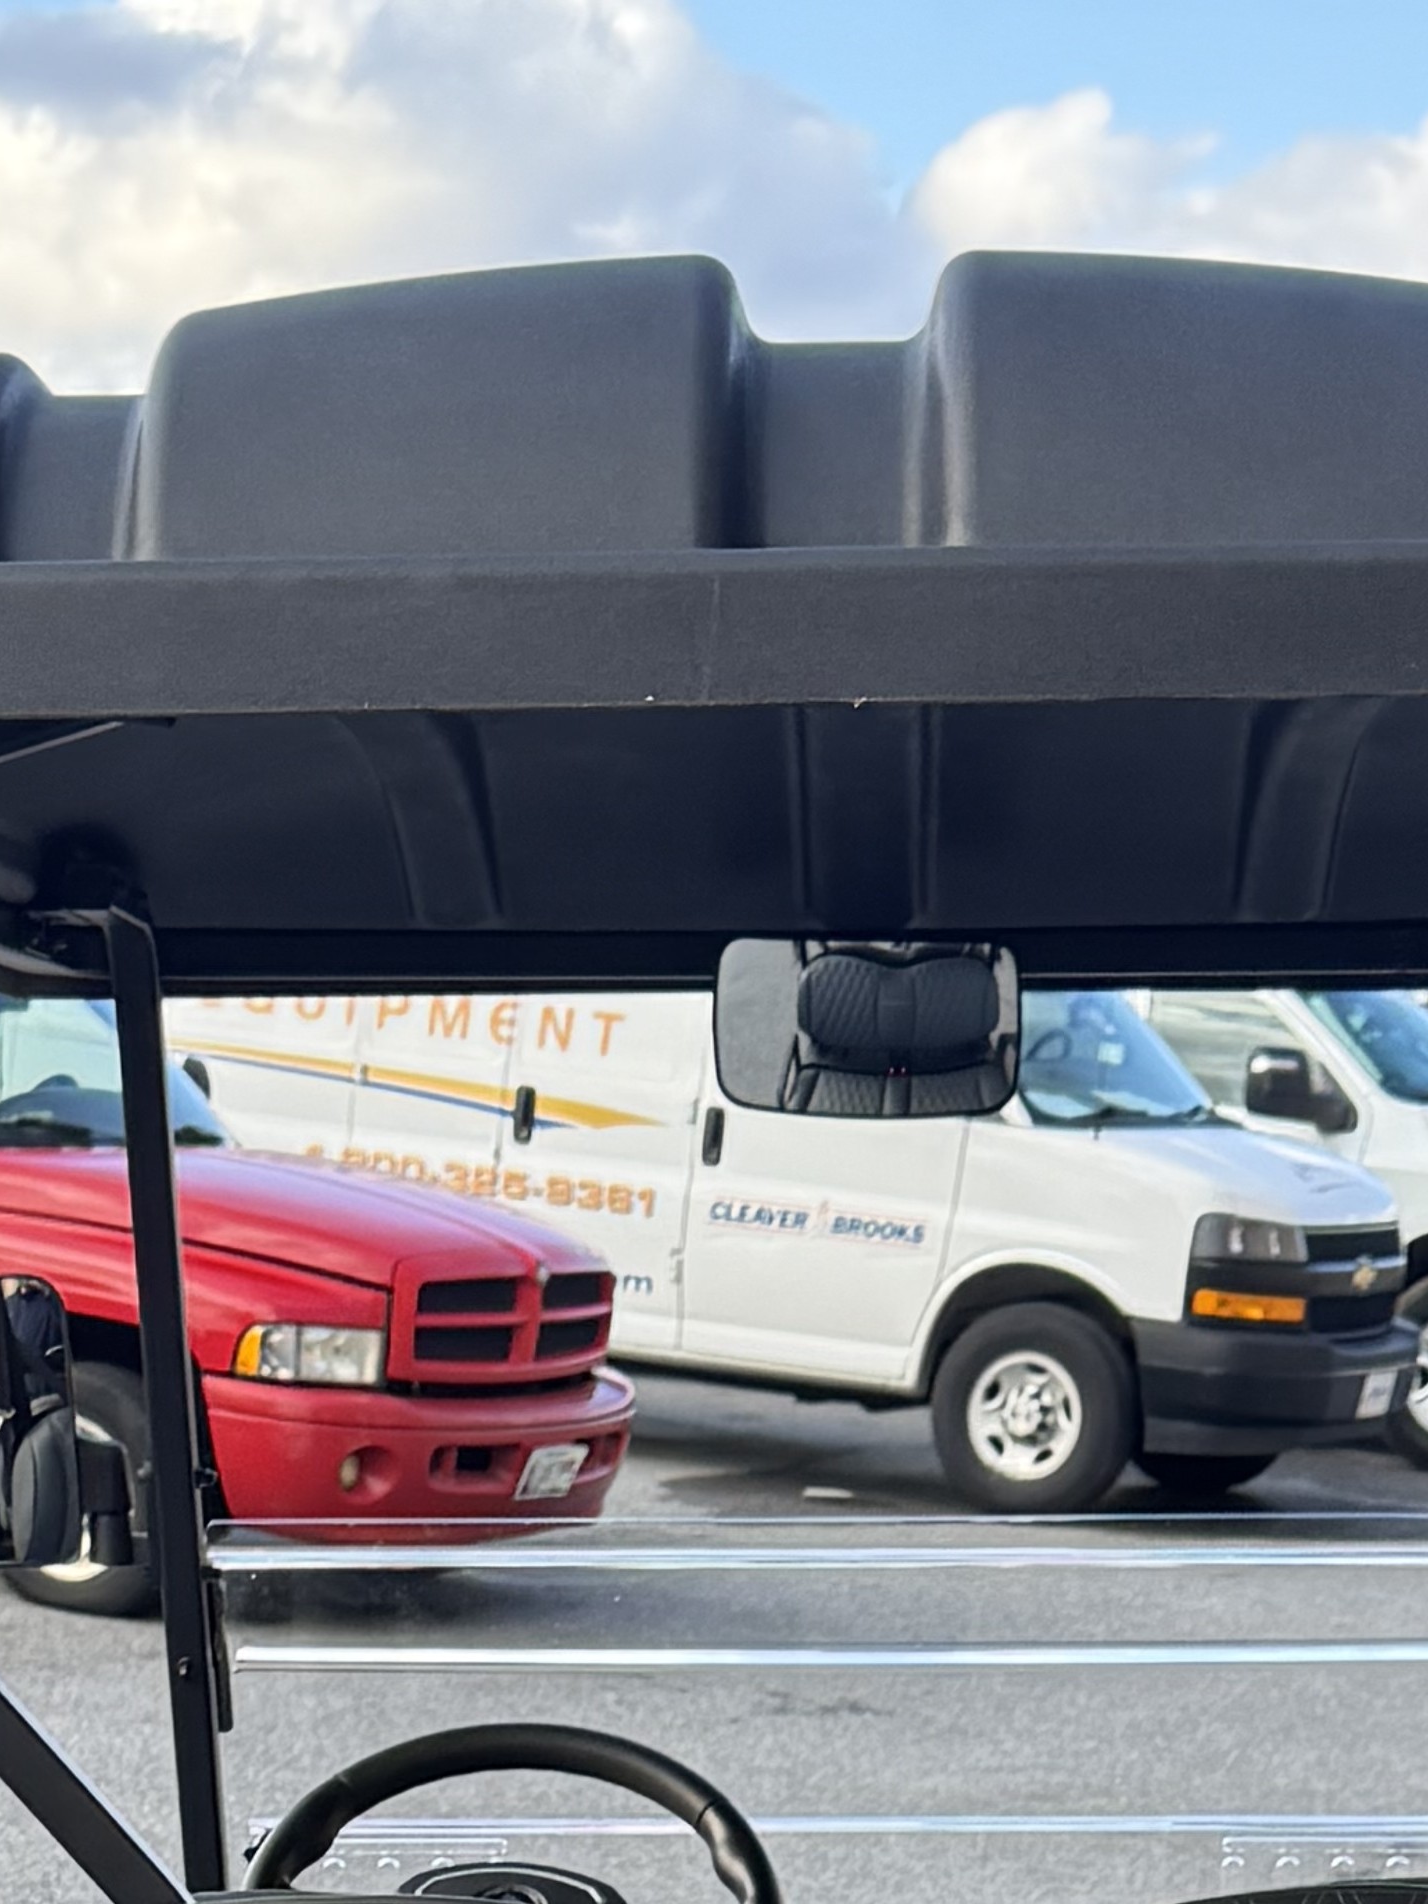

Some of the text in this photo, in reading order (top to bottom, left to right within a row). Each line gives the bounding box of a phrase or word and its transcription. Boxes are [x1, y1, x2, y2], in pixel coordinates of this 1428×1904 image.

[199, 996, 627, 1057] UIPMENT
[708, 1200, 926, 1245] CLEAVER BROOKS
